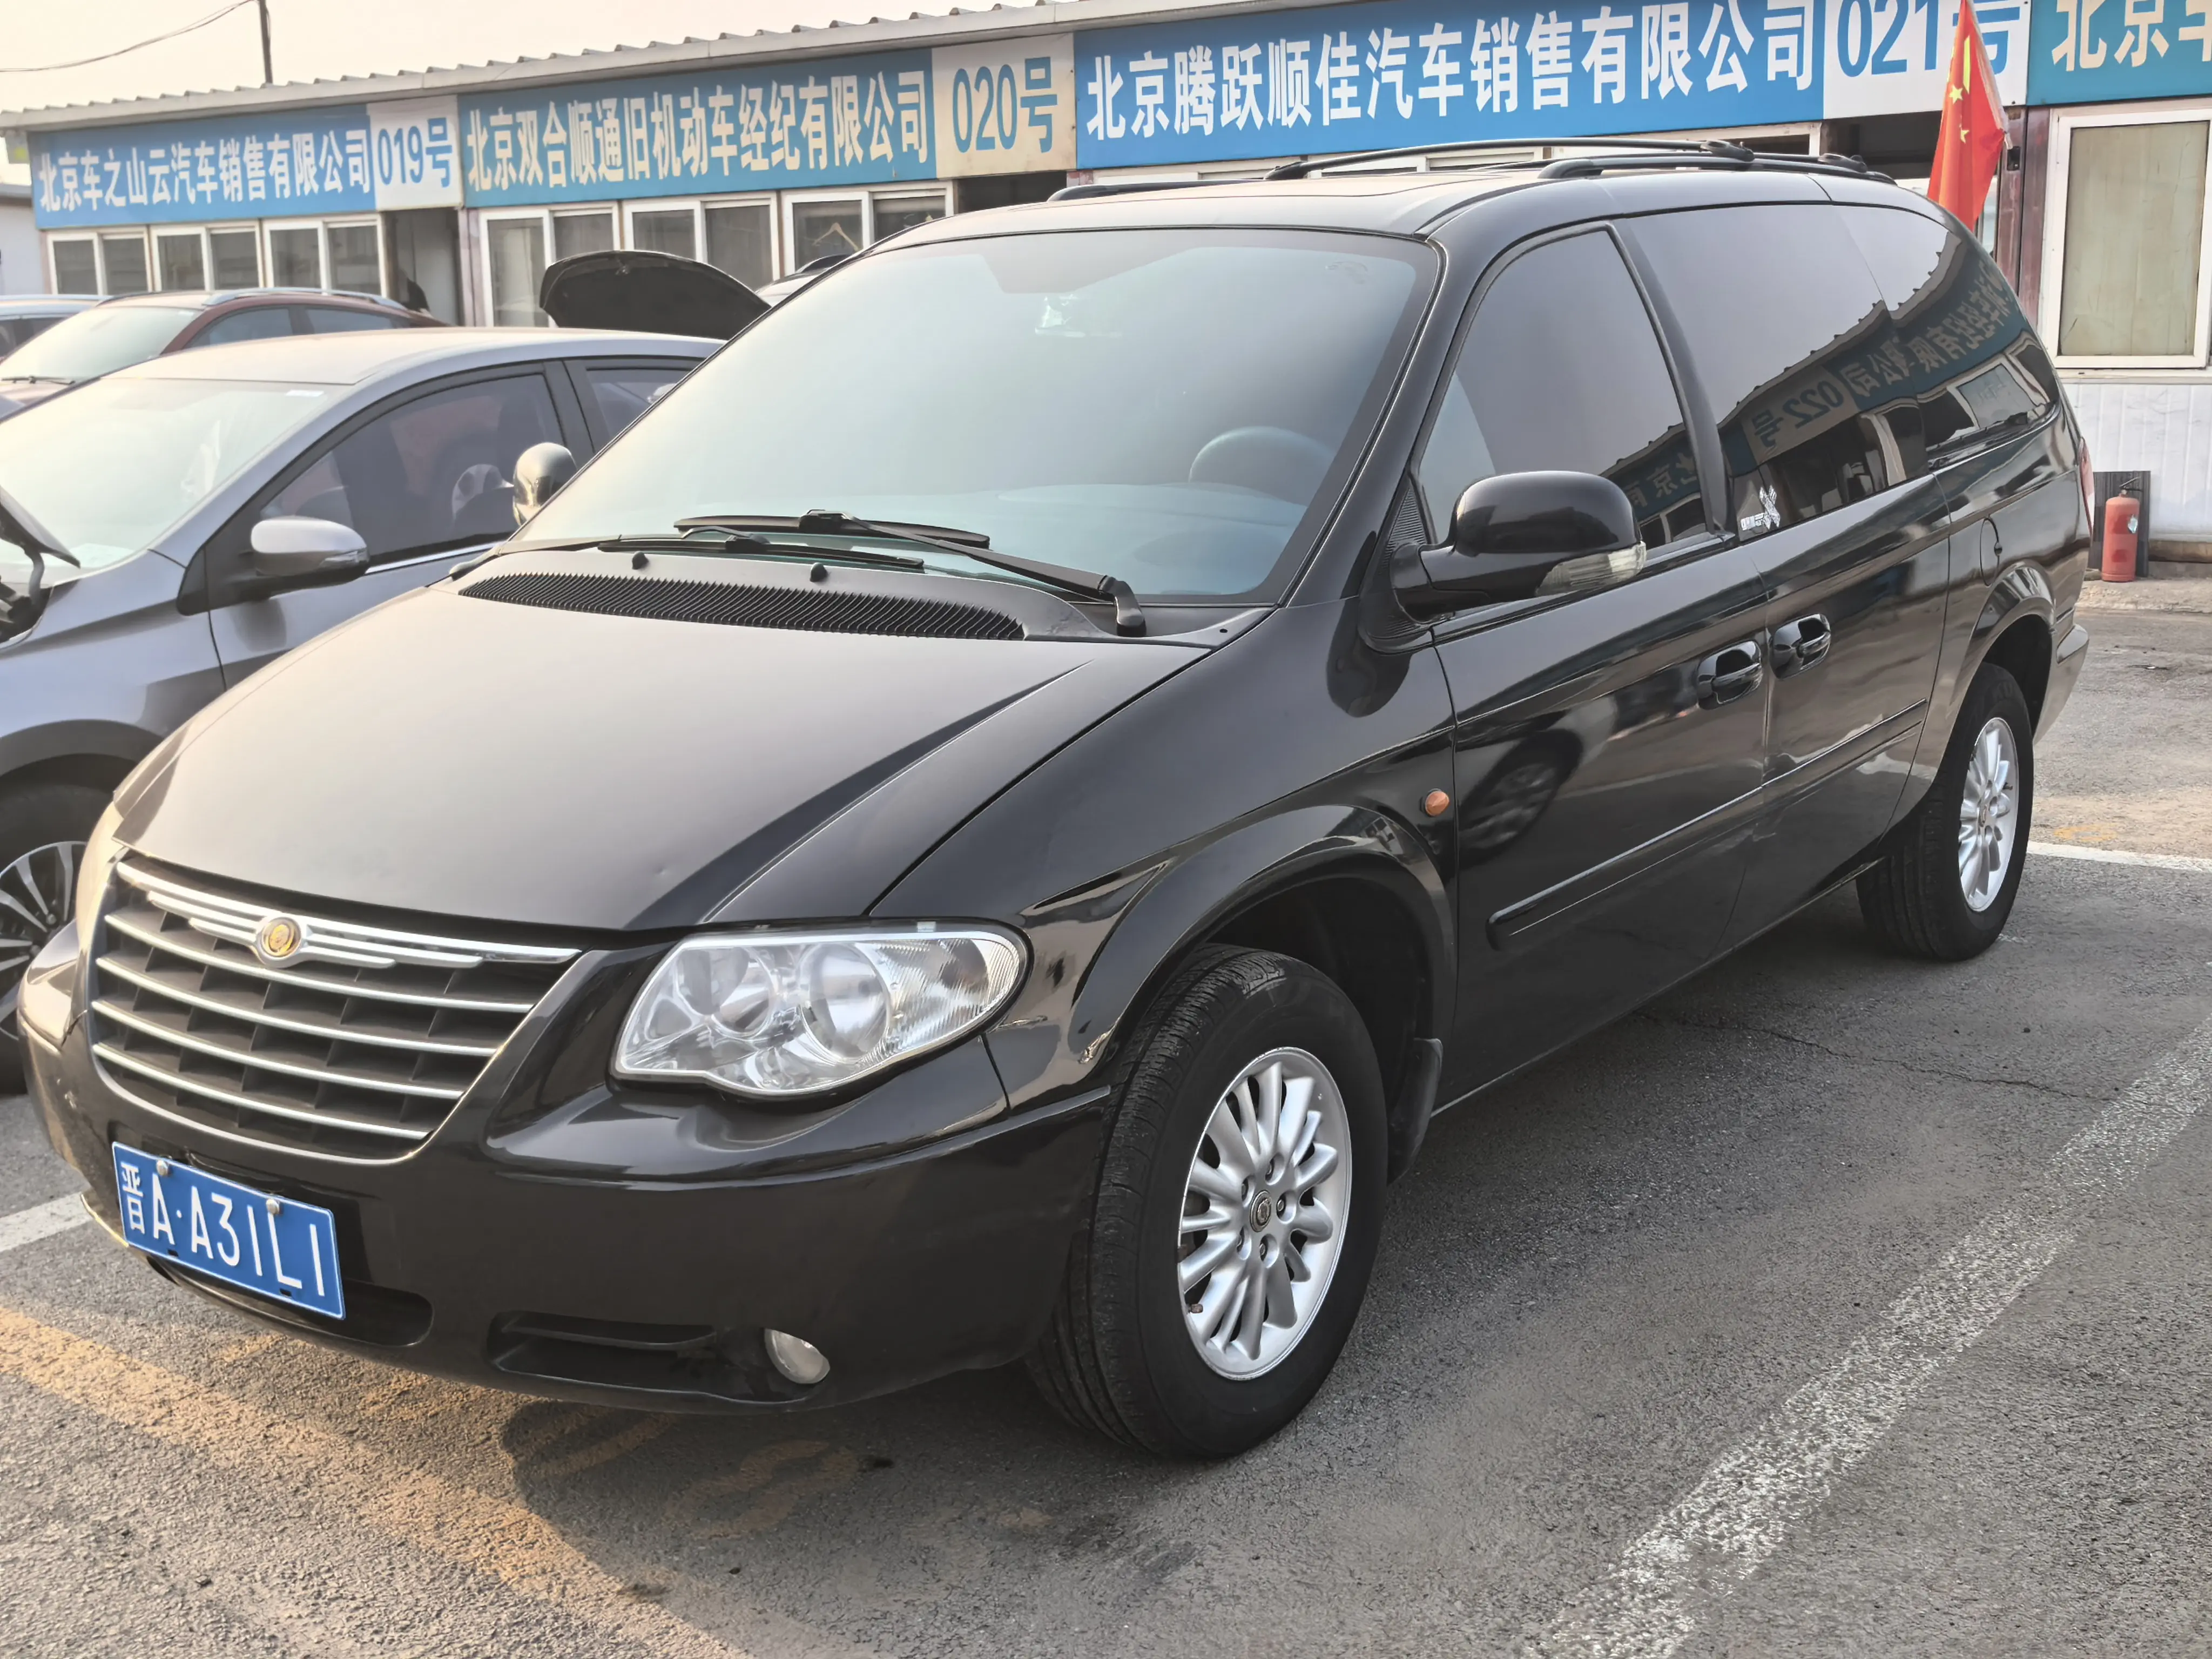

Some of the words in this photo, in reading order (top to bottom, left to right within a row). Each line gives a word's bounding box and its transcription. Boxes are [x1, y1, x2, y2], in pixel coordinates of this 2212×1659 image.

[953, 56, 1058, 153] 020号
[1087, 0, 1814, 140] 北京腾跃顺佳汽车销售有限公司
[39, 130, 370, 212] 北京车之山云汽车销售有限公司
[378, 117, 453, 188] 019号
[467, 71, 928, 192] 北京双合顺通旧机动车经纪有限公司
